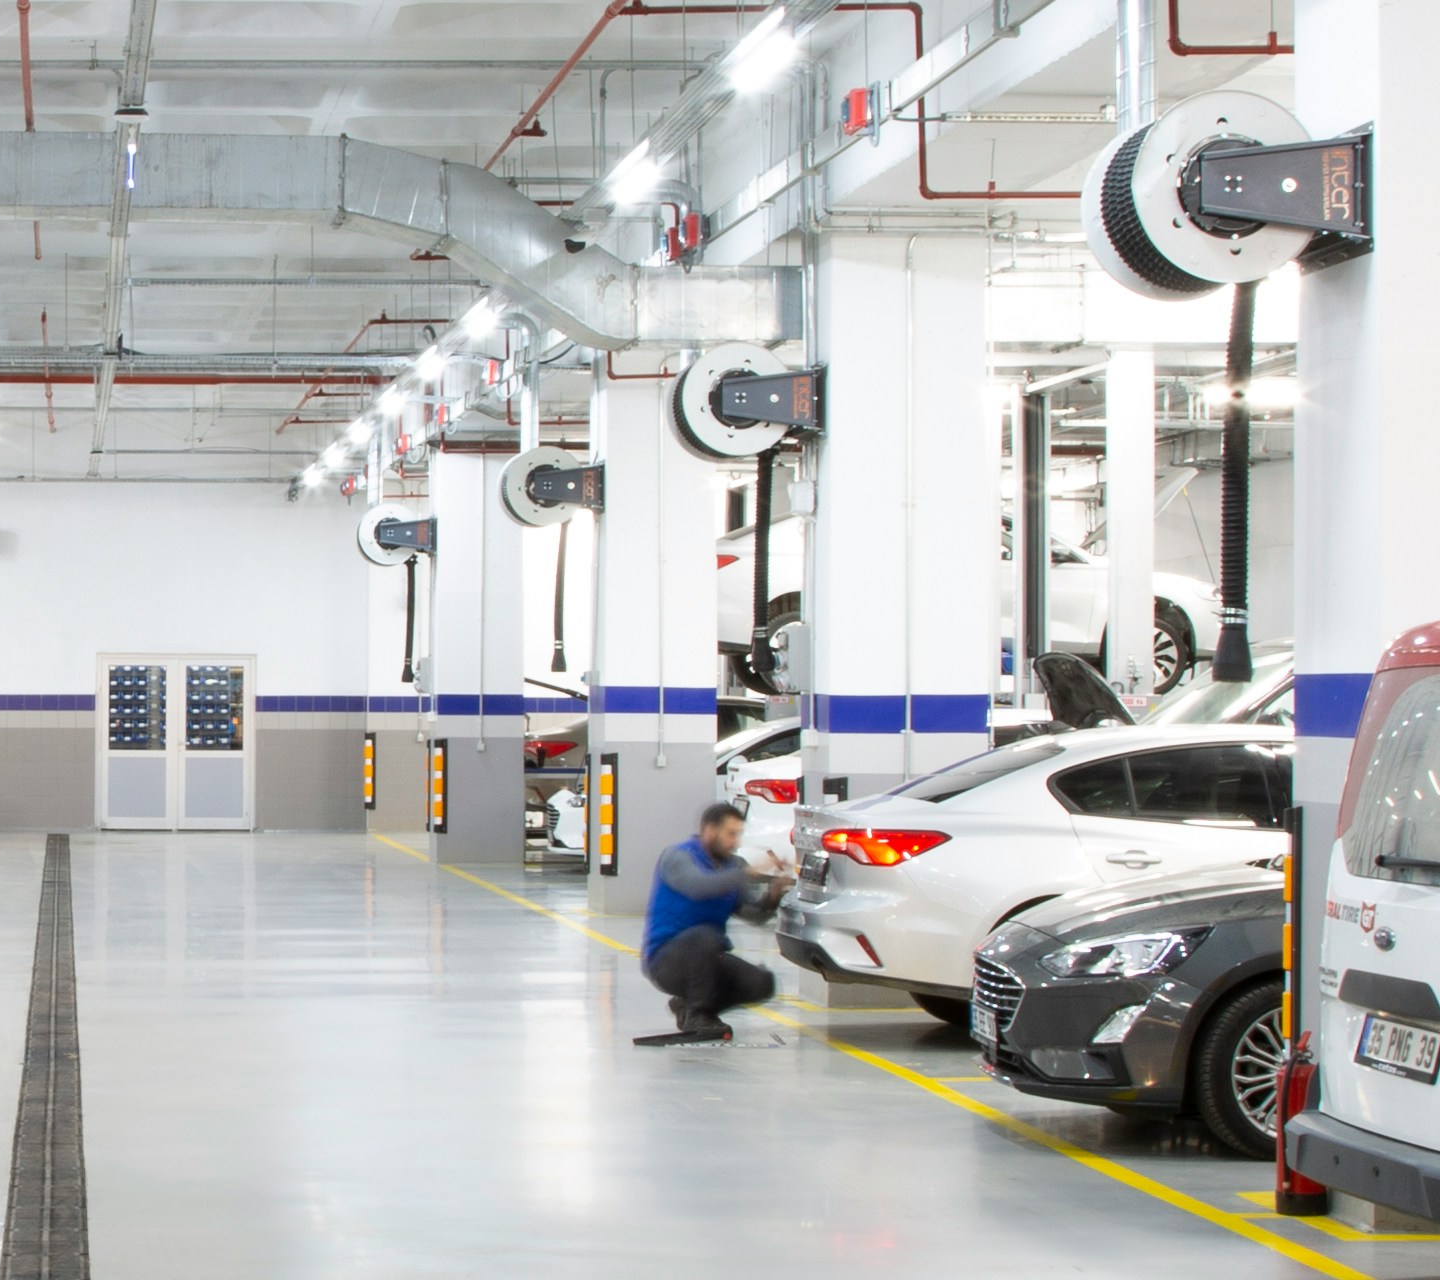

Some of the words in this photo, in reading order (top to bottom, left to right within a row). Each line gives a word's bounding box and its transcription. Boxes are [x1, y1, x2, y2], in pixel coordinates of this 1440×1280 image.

[1330, 147, 1350, 220] inter
[1341, 904, 1361, 924] TIRE
[1367, 1022, 1385, 1056] 35
[1385, 1027, 1414, 1063] PNG
[1415, 1036, 1439, 1069] 39
